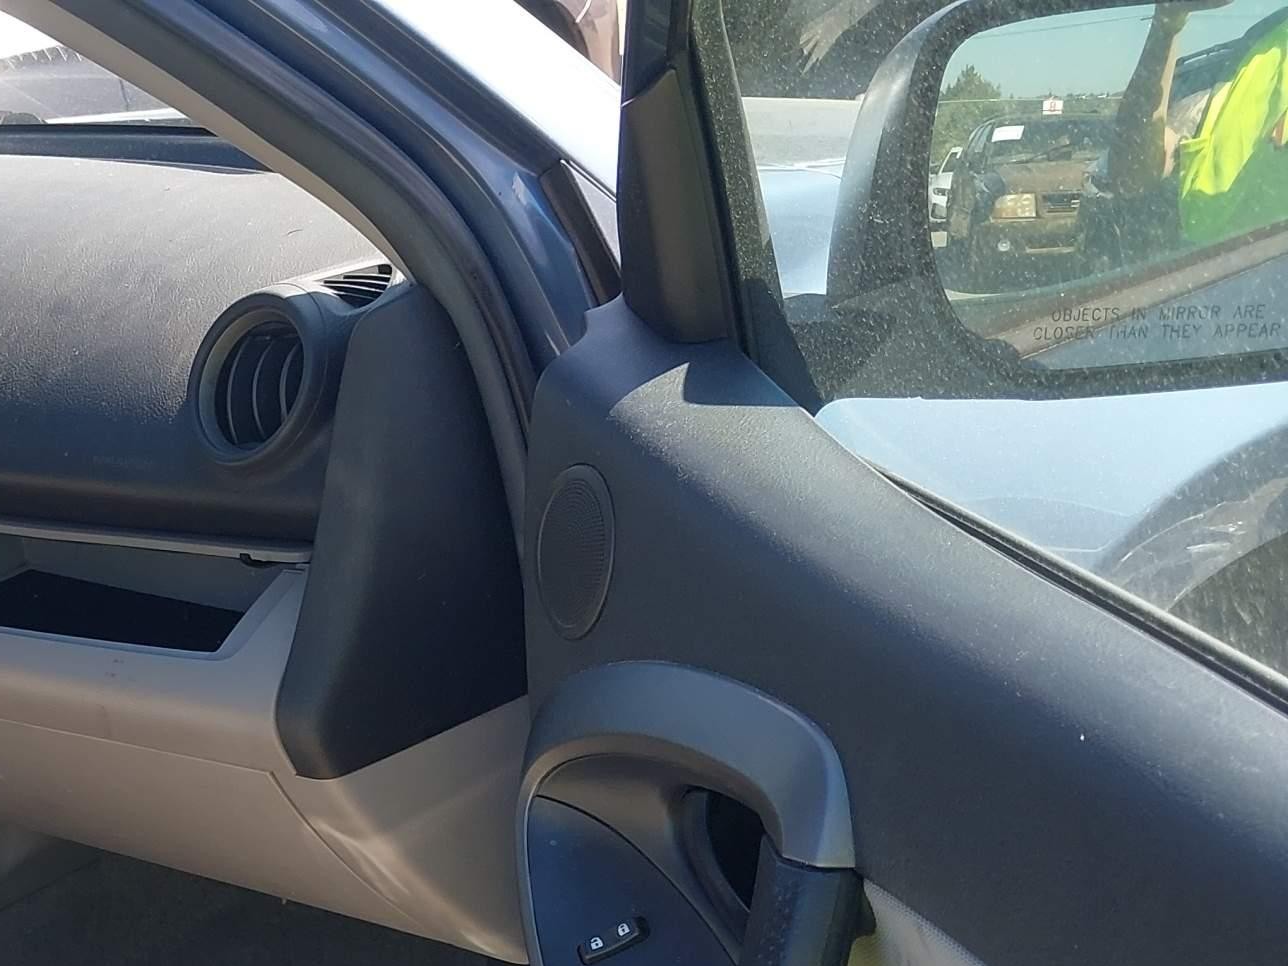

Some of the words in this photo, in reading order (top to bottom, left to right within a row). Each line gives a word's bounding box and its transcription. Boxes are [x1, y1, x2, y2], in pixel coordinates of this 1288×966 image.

[1052, 307, 1121, 322] OBJECTS
[1131, 307, 1146, 321] IN
[1159, 304, 1221, 321] MIRROR
[1233, 304, 1266, 320] ARE
[1033, 326, 1095, 341] CLOSER
[1108, 323, 1149, 340] THAN
[1161, 323, 1202, 339] THEY
[1213, 322, 1281, 338] APPEAR
